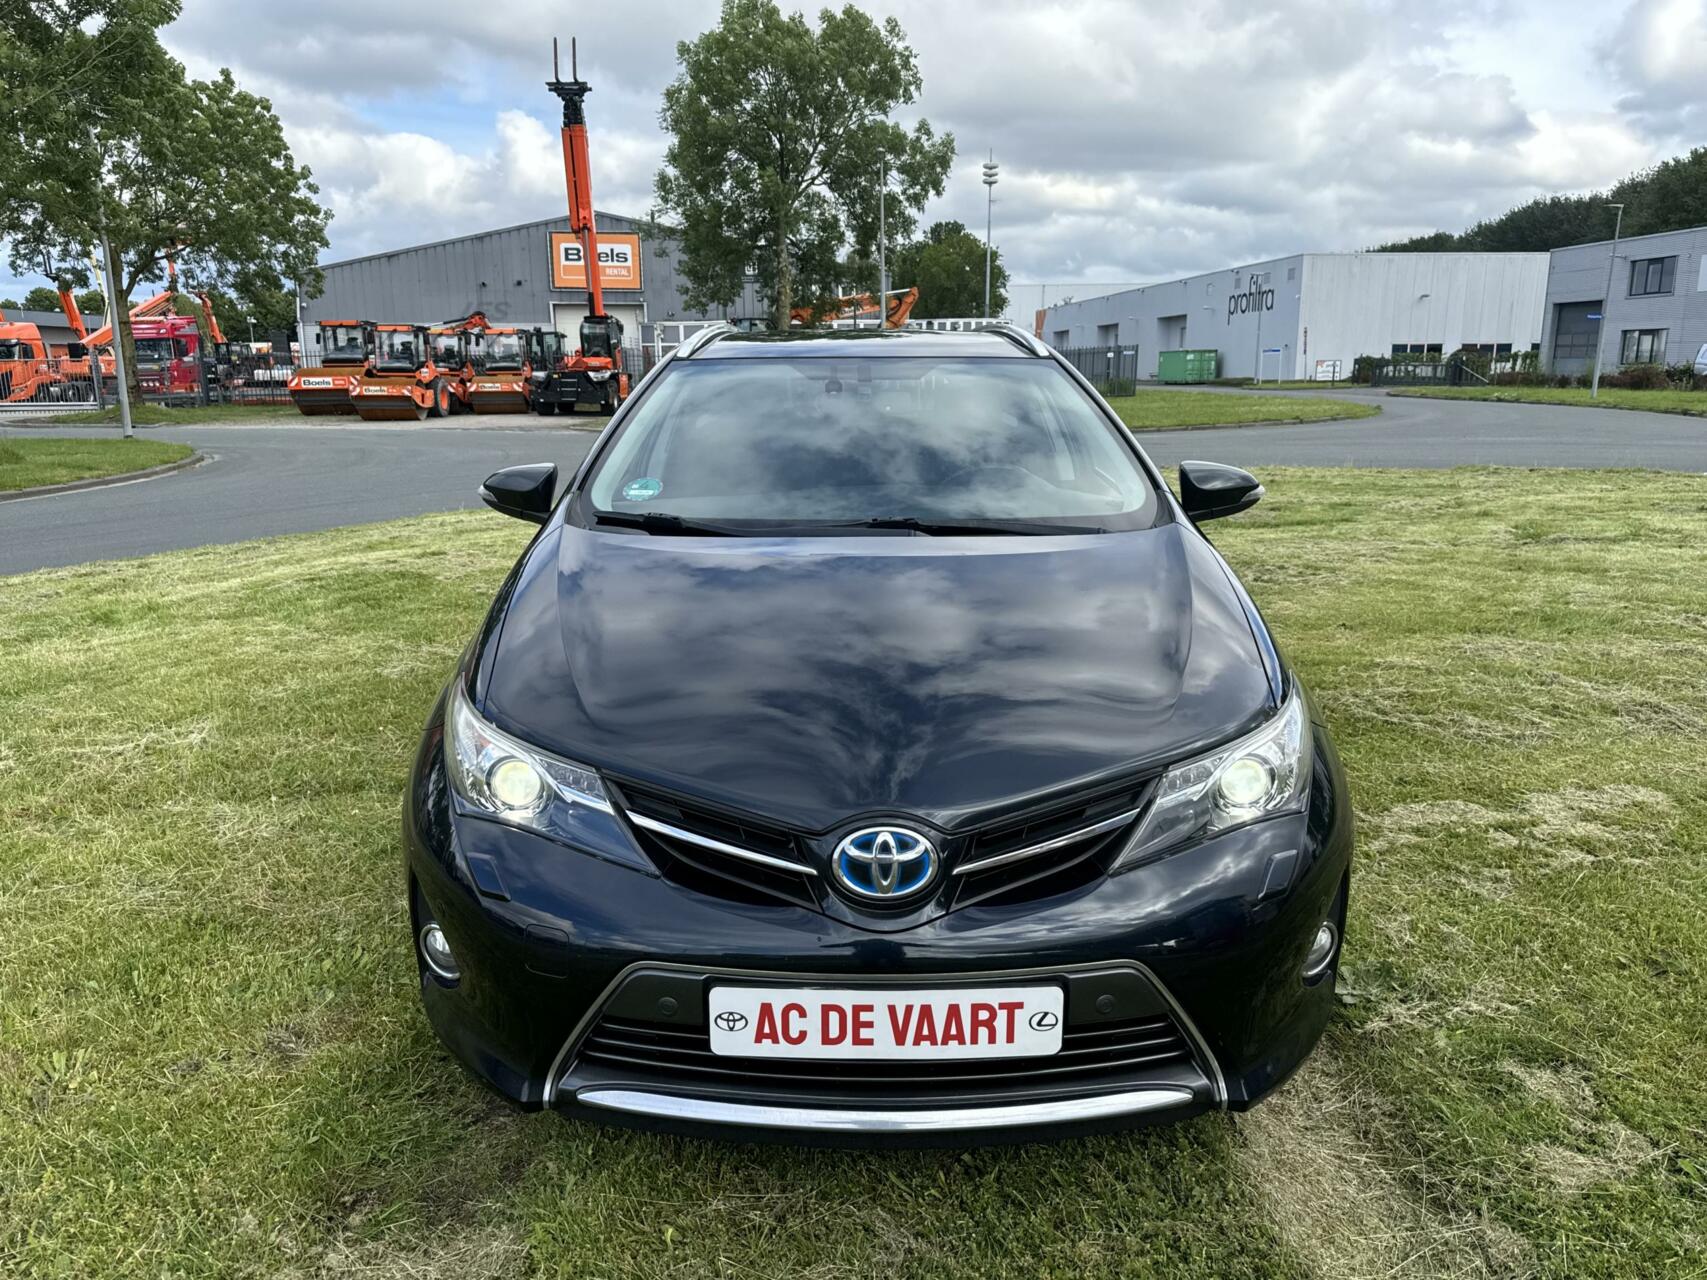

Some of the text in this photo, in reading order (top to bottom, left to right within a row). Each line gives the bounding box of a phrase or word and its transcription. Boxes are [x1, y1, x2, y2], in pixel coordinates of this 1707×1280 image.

[564, 247, 629, 263] Bels
[605, 268, 629, 276] RENTAL
[1227, 274, 1275, 326] profiltra
[753, 1001, 1025, 1047] AC DE VAART
